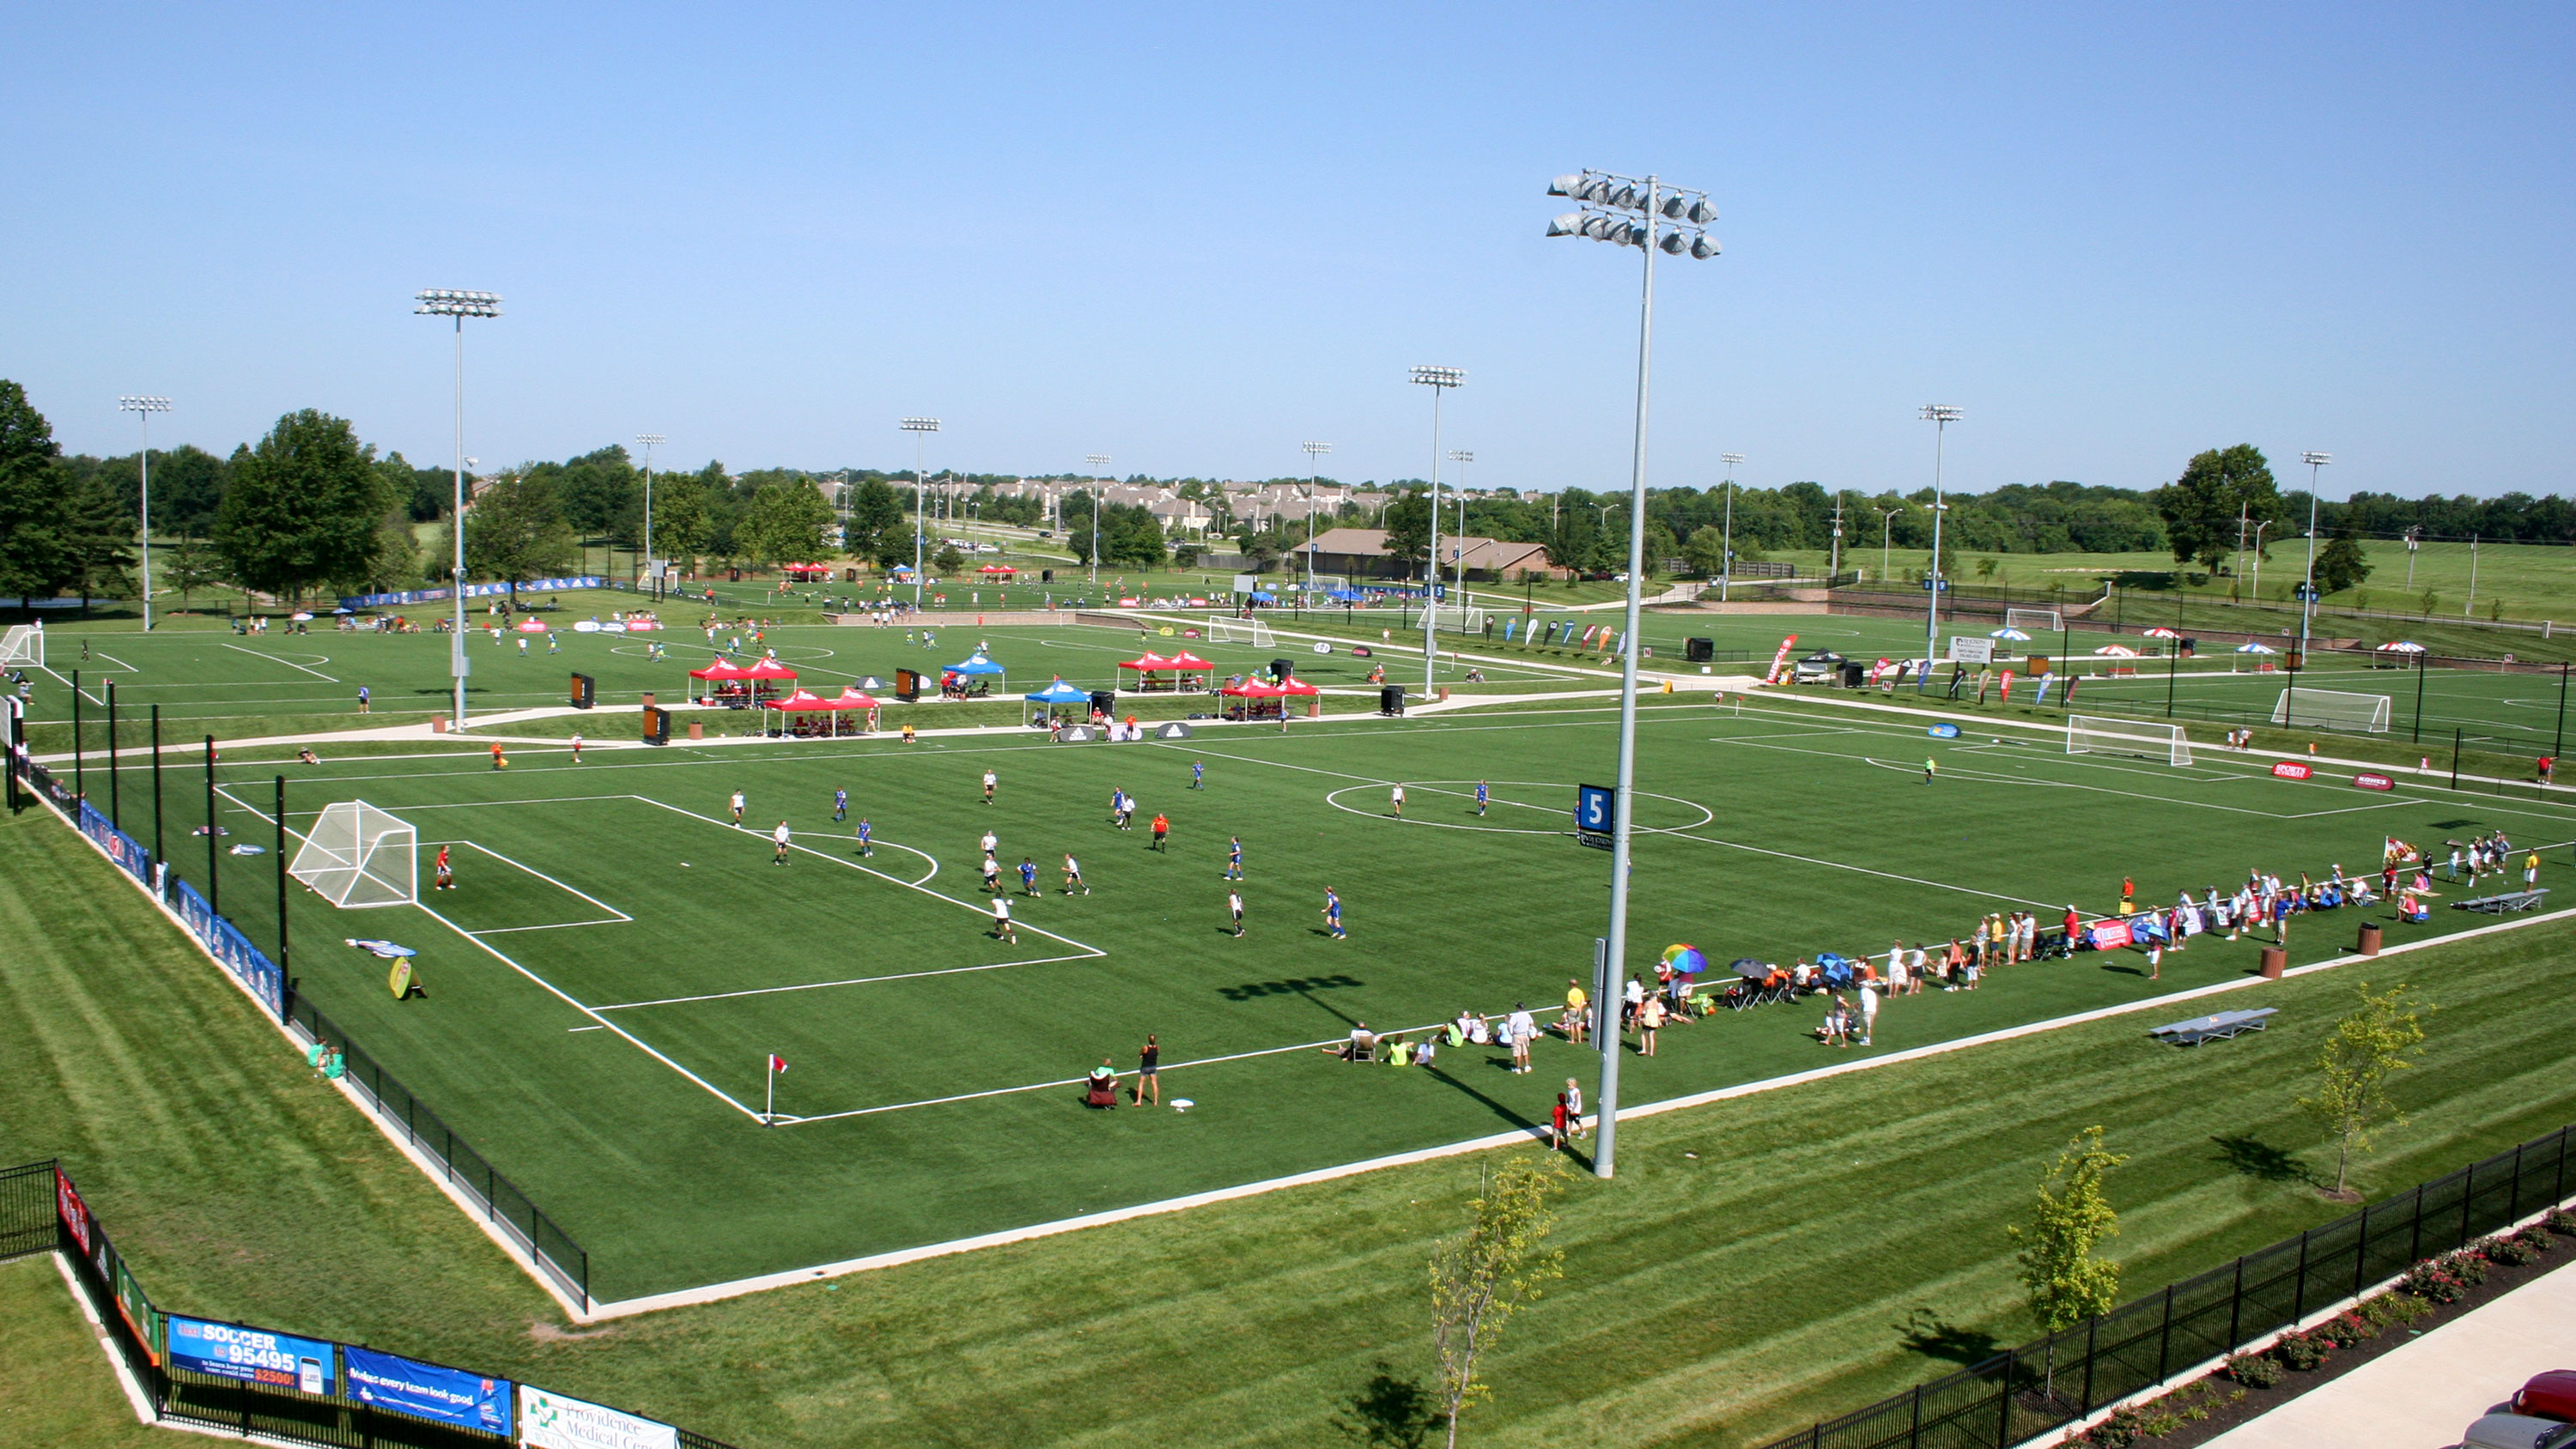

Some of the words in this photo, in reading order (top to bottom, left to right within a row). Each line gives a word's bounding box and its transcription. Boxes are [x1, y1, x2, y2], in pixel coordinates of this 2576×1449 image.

[1437, 586, 1443, 596] 5
[1767, 647, 1788, 681] MEDICAL
[2275, 763, 2306, 773] SPORTS
[1589, 793, 1602, 824] 5
[179, 1324, 199, 1337] Text
[203, 1325, 277, 1351] SOCCER
[216, 1346, 225, 1356] to
[228, 1344, 295, 1372] 95495
[240, 1365, 254, 1373] your
[254, 1368, 295, 1386] $2500!
[349, 1367, 380, 1385] Makes
[380, 1377, 405, 1391] every
[405, 1380, 428, 1395] team
[429, 1386, 449, 1400] look
[449, 1393, 475, 1406] good.
[565, 1403, 641, 1436] Providence
[567, 1420, 618, 1447] Medical
